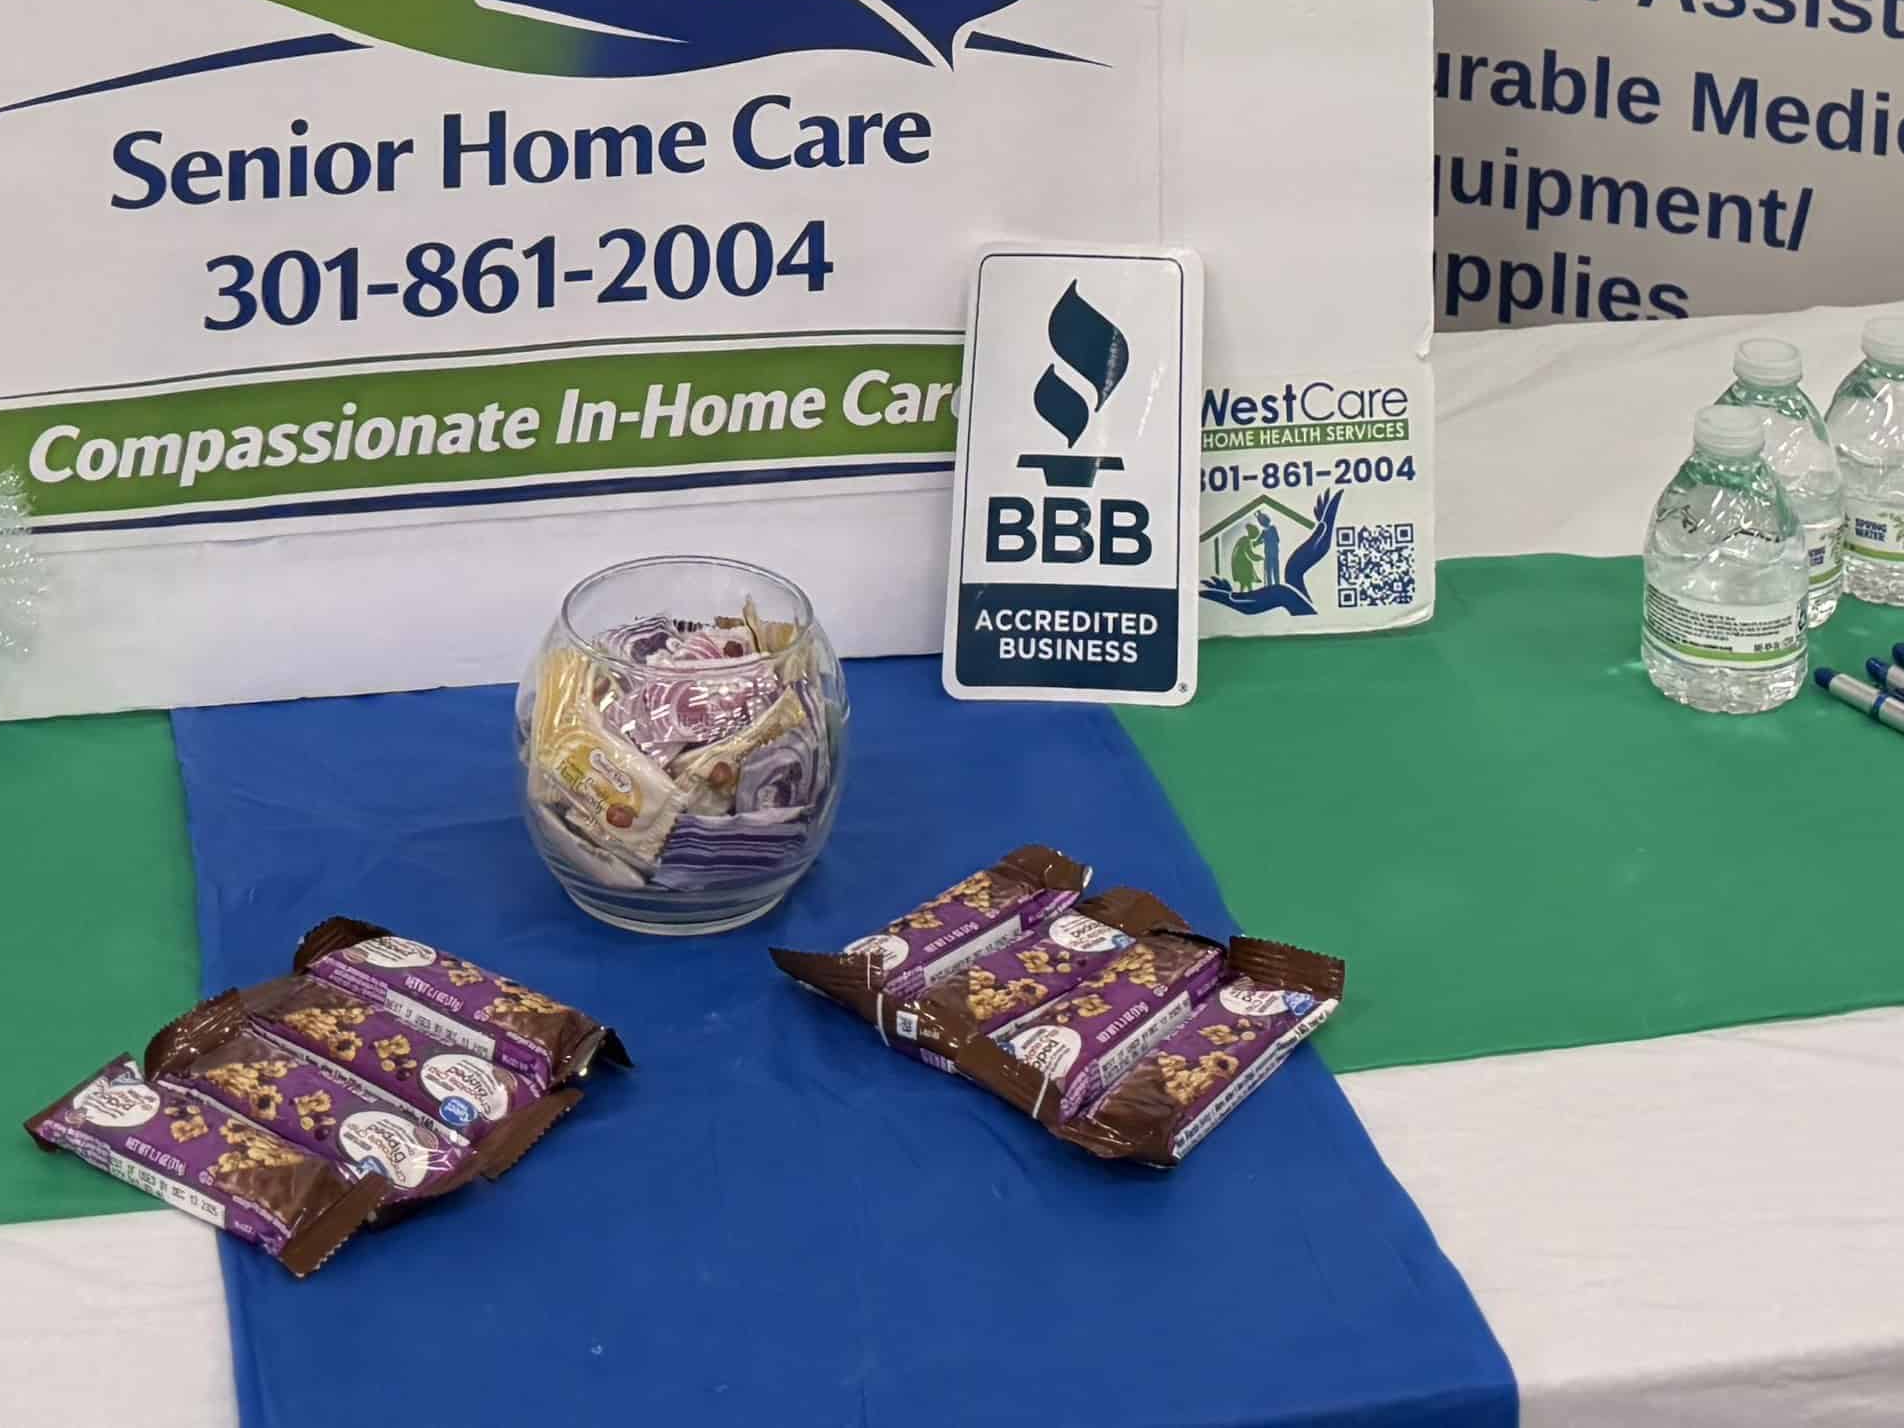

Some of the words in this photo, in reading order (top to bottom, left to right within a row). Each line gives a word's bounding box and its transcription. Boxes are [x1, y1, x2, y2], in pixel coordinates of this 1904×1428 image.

[1434, 49, 1661, 125] rable
[110, 119, 413, 210] Senior
[442, 110, 707, 190] Home
[732, 94, 932, 171] Care
[1434, 147, 1814, 252] uipment/
[202, 219, 834, 332] 301-861-2004
[1434, 249, 1689, 324] pplies
[28, 401, 533, 487] Compassionate
[556, 376, 826, 446] In-Home
[1203, 430, 1254, 449] HOME
[1260, 426, 1320, 445] HEALTH
[1326, 422, 1404, 442] SERVICES
[985, 496, 1153, 566] BBB
[975, 609, 1158, 636] ACCREDITED
[999, 638, 1139, 664] BUSINESS
